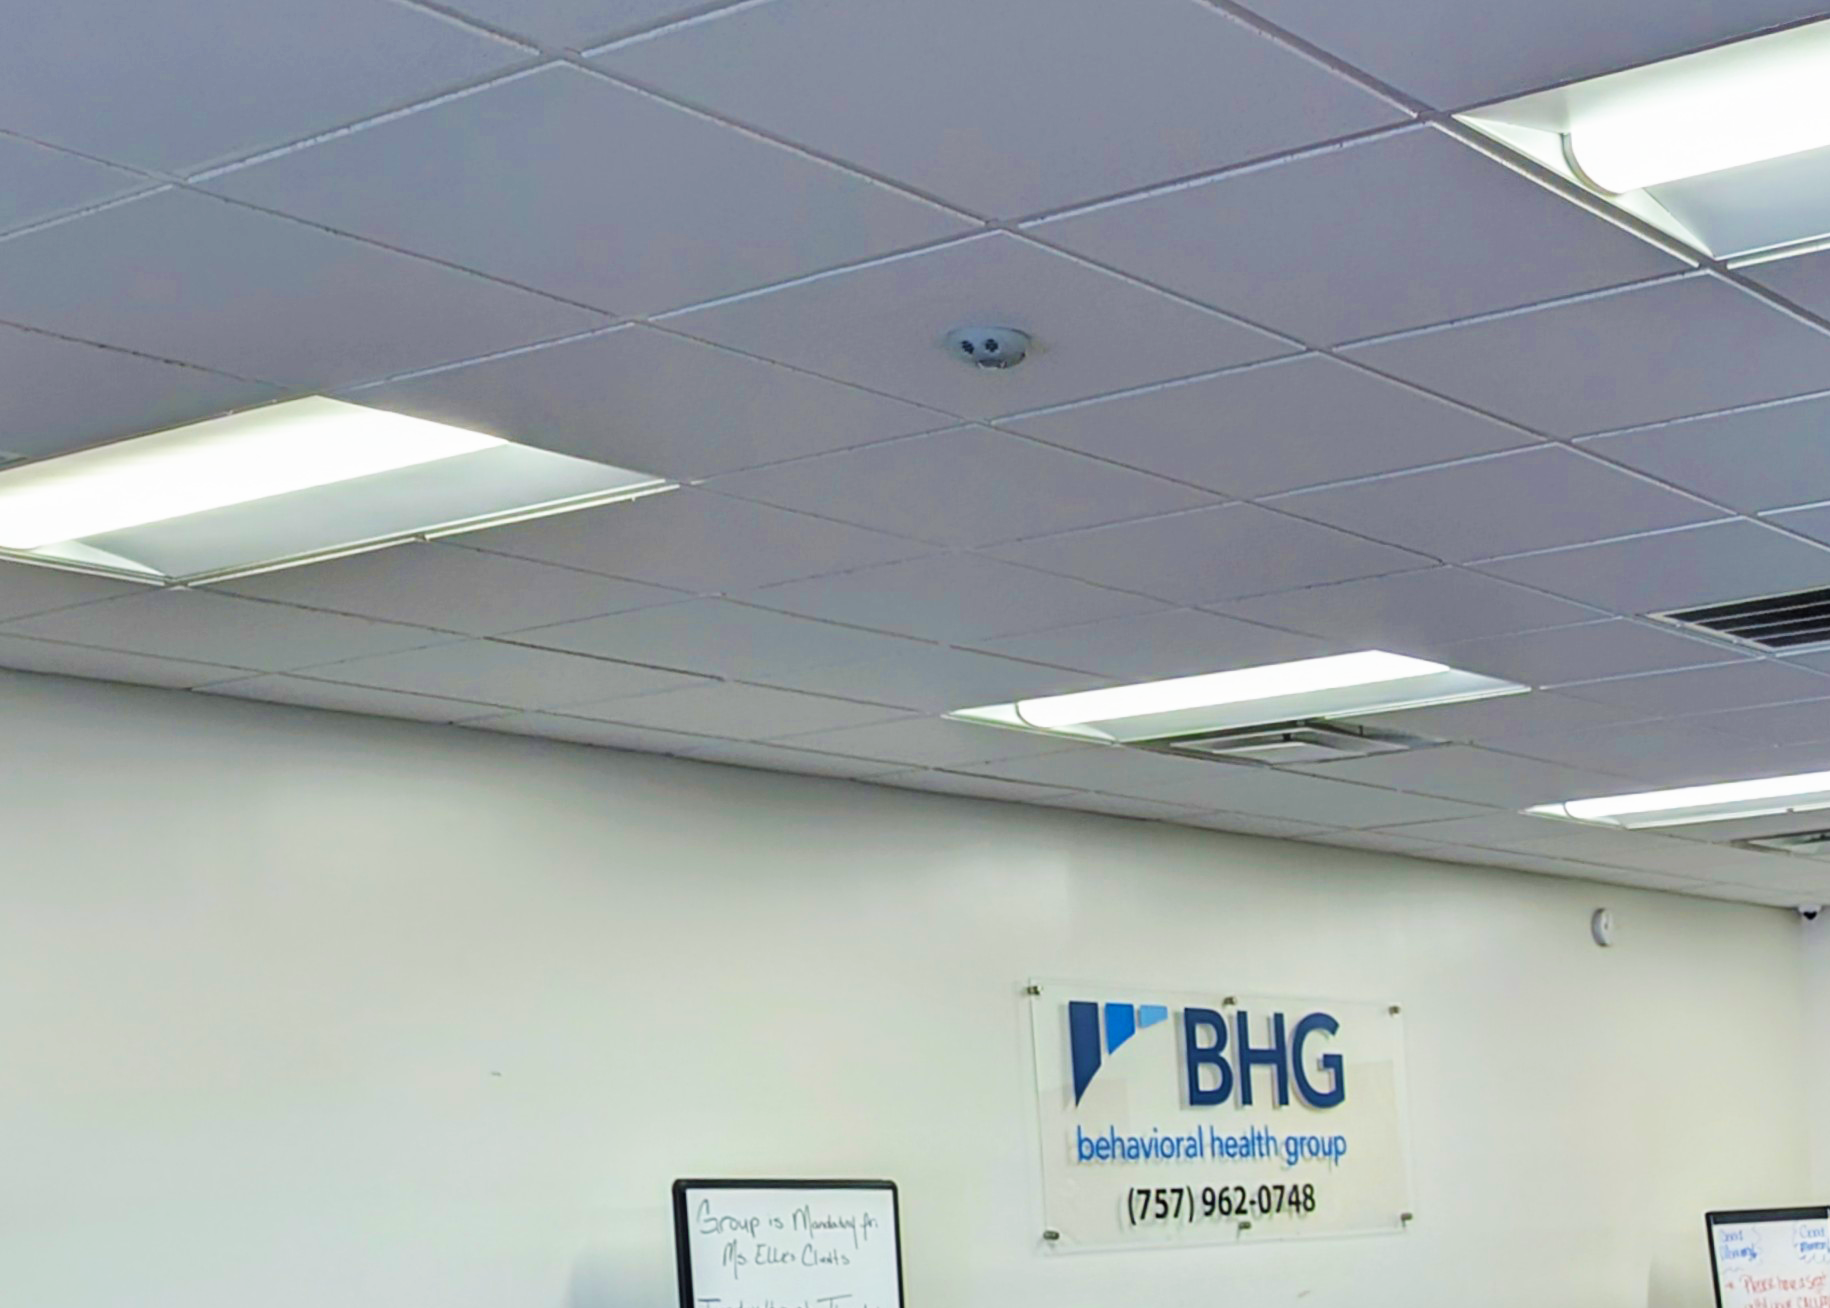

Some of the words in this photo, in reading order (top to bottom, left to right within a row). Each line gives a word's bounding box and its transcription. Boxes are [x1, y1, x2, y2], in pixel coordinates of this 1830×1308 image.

[1184, 1007, 1346, 1109] BHG
[1077, 1125, 1204, 1161] behavioral
[1210, 1126, 1277, 1159] health
[1286, 1134, 1347, 1167] group
[697, 1198, 760, 1238] Group
[768, 1217, 784, 1230] is
[1128, 1186, 1195, 1225] (757)
[1201, 1183, 1316, 1217] 962-0748
[723, 1239, 747, 1280] Ms
